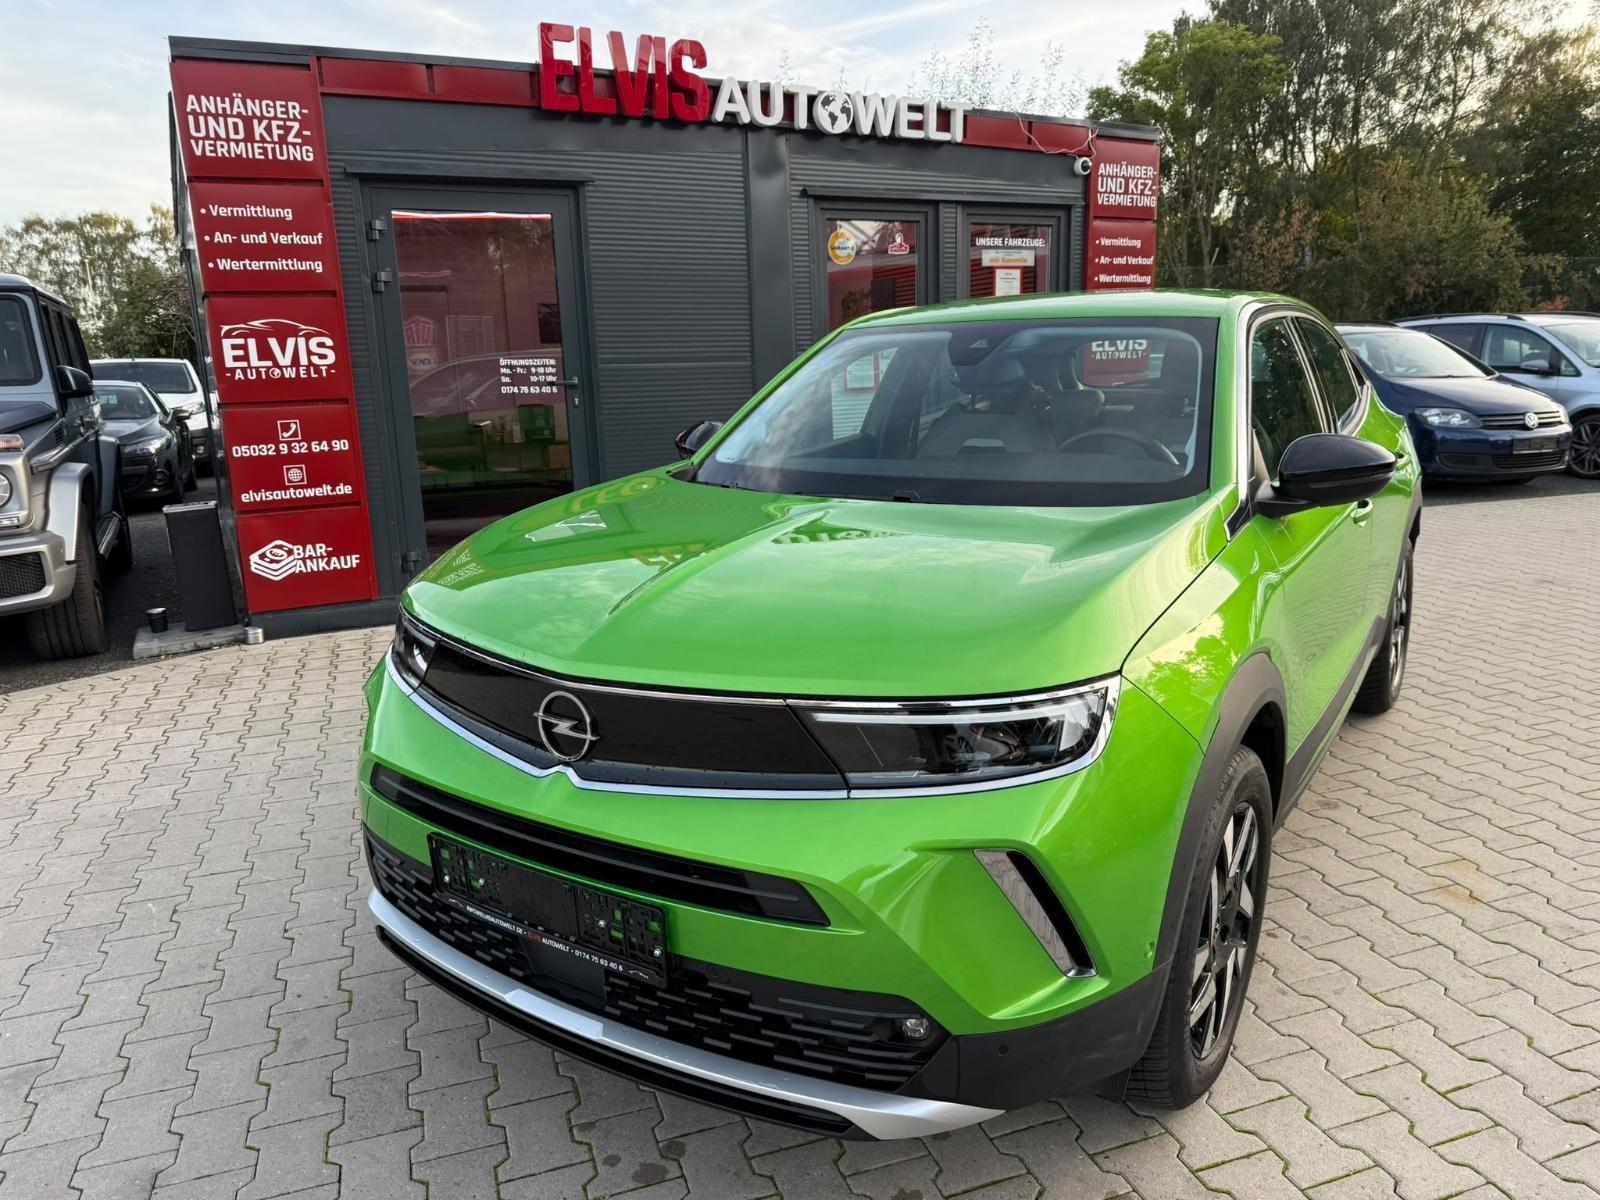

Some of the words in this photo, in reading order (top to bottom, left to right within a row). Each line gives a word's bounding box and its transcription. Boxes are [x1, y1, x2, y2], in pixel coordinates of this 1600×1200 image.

[537, 22, 711, 122] ELVIS
[711, 77, 972, 142] AUTOWELT
[186, 93, 309, 120] ANHÄNGER-
[187, 115, 244, 140] UND
[253, 119, 311, 143] KFZ-
[190, 140, 314, 161] VERMIETUNG
[1098, 162, 1157, 179] ANHÄNGER-
[1097, 177, 1124, 193] UND
[1128, 179, 1157, 195] KFZ-
[1097, 193, 1157, 207] VERMIETUNG
[209, 204, 293, 220] Vermittlung
[214, 232, 237, 244] An-
[241, 232, 267, 244] und
[270, 233, 323, 245] Verkauf
[975, 237, 1003, 246] UNSERE
[1004, 238, 1045, 247] FAHRZEUGE:
[1100, 237, 1141, 248] Vermittlung
[217, 258, 323, 273] Wertermittlung
[1100, 256, 1111, 264] An-
[1113, 256, 1126, 264] und
[1128, 256, 1153, 265] Verkauf
[1099, 274, 1151, 284] Wertermittlung
[221, 336, 336, 369] ELVIS
[1091, 339, 1147, 352] ELVIS
[499, 358, 557, 366] ÖFFNUNGSZEITEN:
[501, 386, 519, 394] 0174
[520, 386, 529, 394] 75
[232, 445, 276, 458] 05032
[280, 443, 288, 454] 9
[291, 442, 309, 454] 32
[311, 441, 329, 452] 64
[332, 440, 349, 452] 90
[241, 482, 353, 503] elvisautowelt.de
[293, 543, 333, 559] BAR-
[295, 554, 360, 573] ANKAUF
[541, 937, 570, 952] AUTOWELT
[574, 949, 590, 960] 0174
[591, 955, 599, 963] 75
[599, 958, 608, 966] 63
[609, 962, 618, 970] 40
